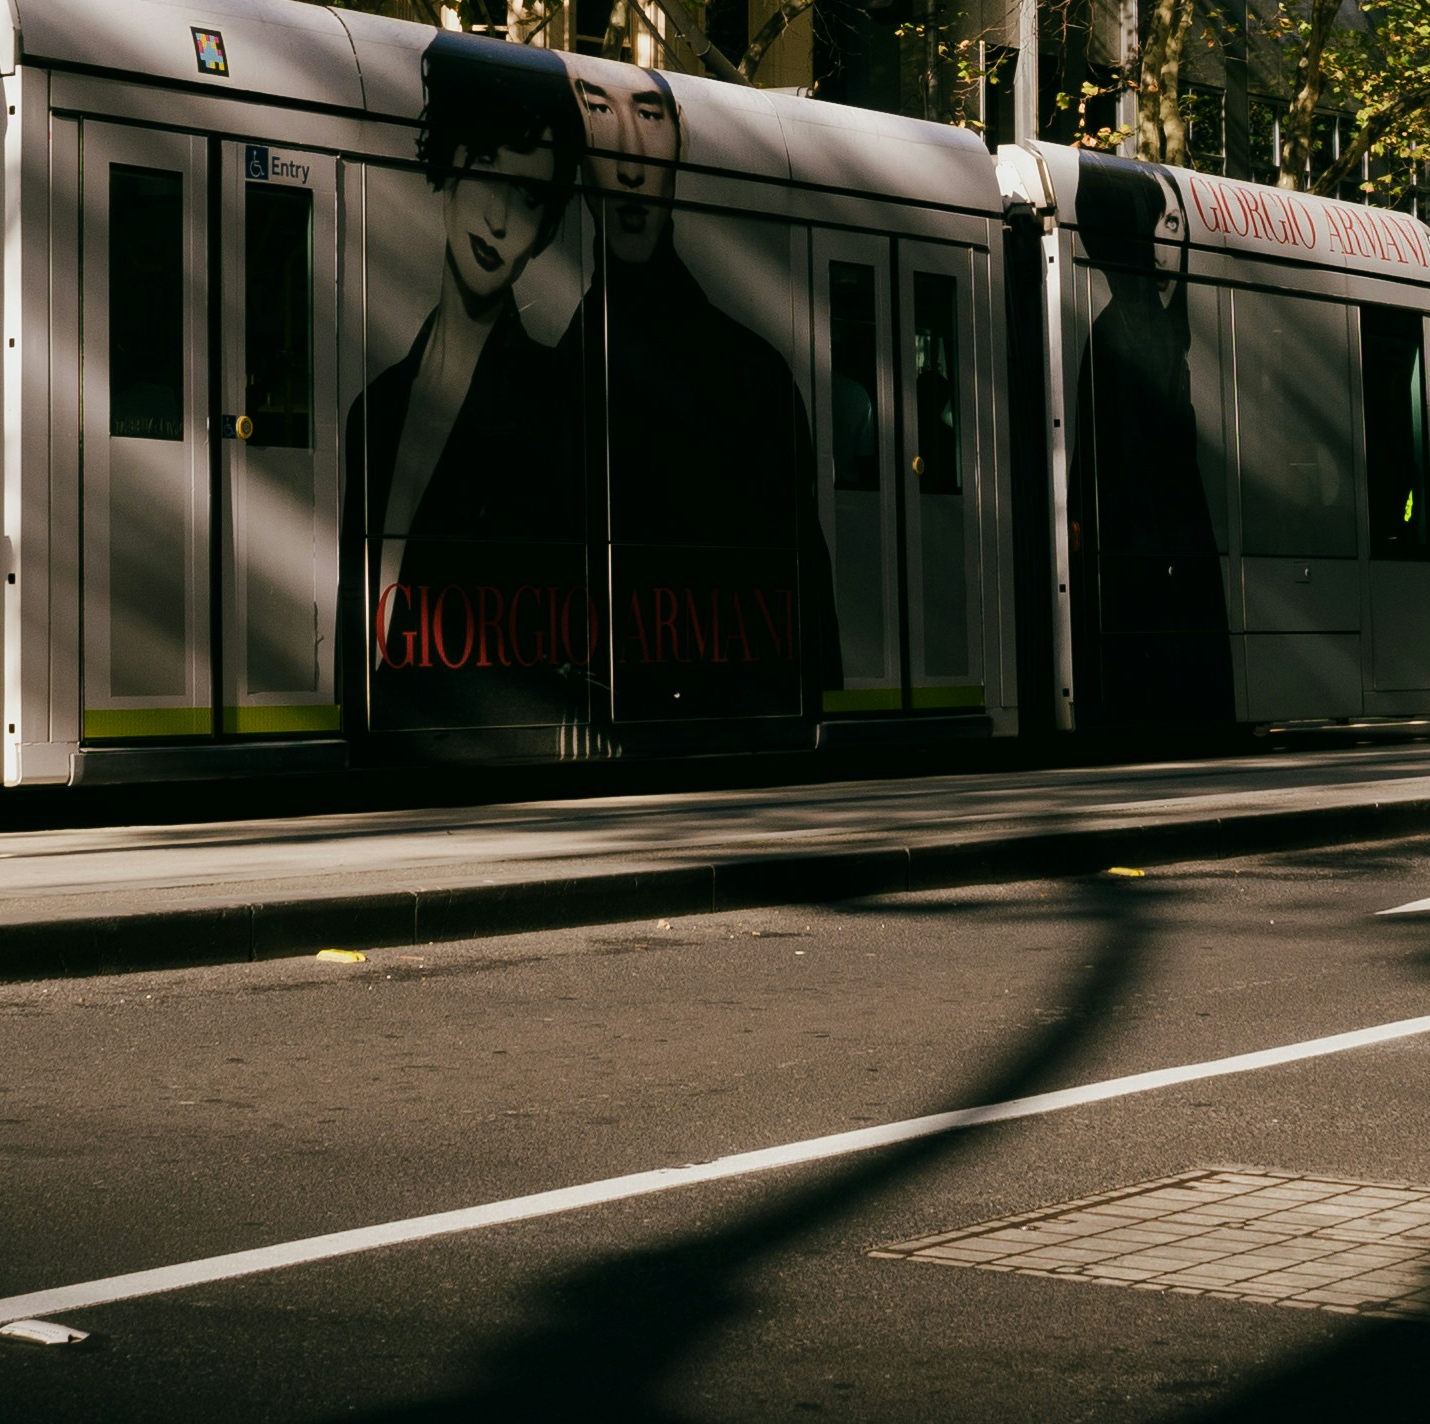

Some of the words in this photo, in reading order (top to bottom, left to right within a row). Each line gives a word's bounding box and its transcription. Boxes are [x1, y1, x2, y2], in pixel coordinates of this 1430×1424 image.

[271, 156, 310, 184] Entry
[1189, 176, 1316, 250] GIORGIO
[1322, 204, 1429, 268] ARMANI
[375, 582, 600, 670] GIORGIO
[618, 585, 797, 665] ARMANI
